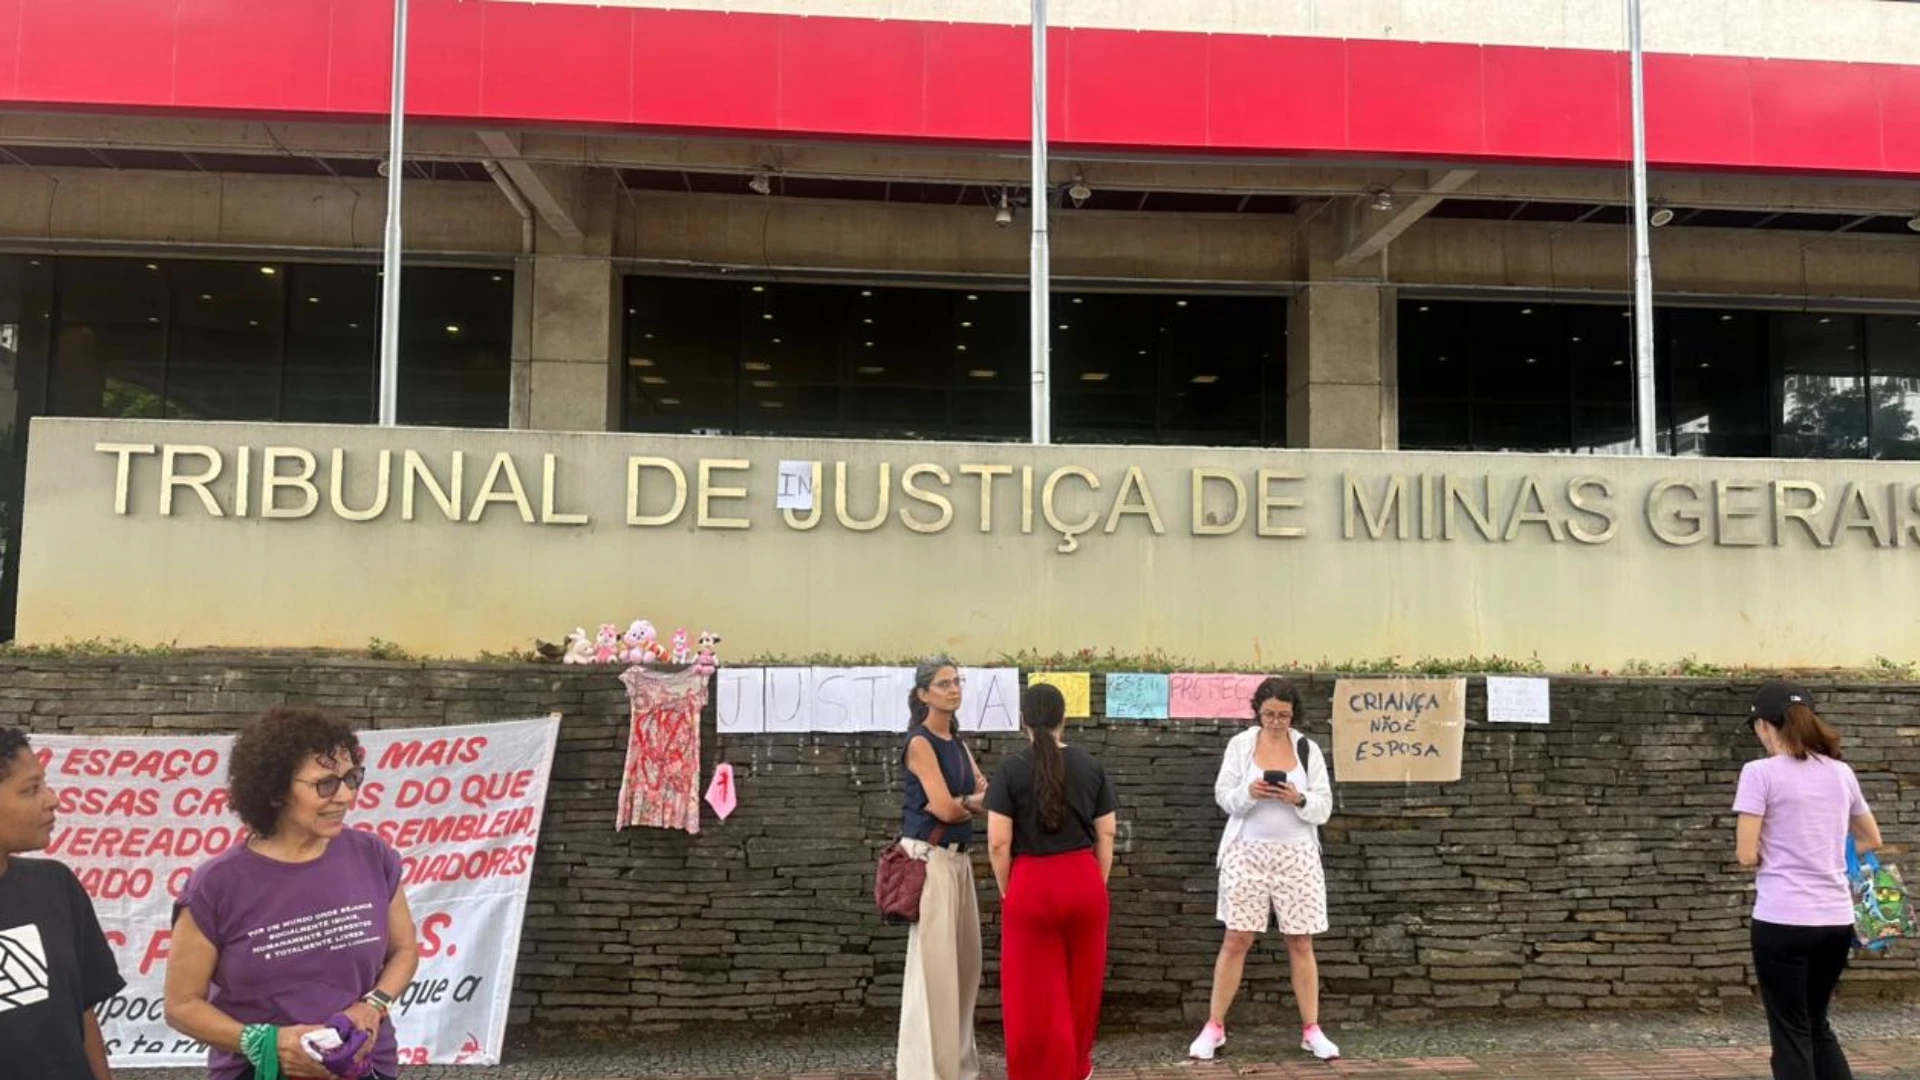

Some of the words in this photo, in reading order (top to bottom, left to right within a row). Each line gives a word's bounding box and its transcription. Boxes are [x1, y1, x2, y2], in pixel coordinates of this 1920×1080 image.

[95, 443, 588, 524] TRIBUNAL
[626, 456, 752, 529] DE
[783, 461, 1165, 553] JUSTIÇA
[1191, 468, 1307, 538] DE
[1342, 472, 1619, 545] MINAS
[778, 472, 812, 496] IN
[718, 673, 1013, 729] JUSTA
[1349, 691, 1440, 718] CRIANÇA
[61, 749, 219, 782] ESPAÇO
[377, 736, 488, 769] MAIS
[1355, 740, 1441, 761] ESPOSA
[395, 776, 452, 809] DO
[460, 769, 534, 808] QUE
[452, 974, 483, 1003] a
